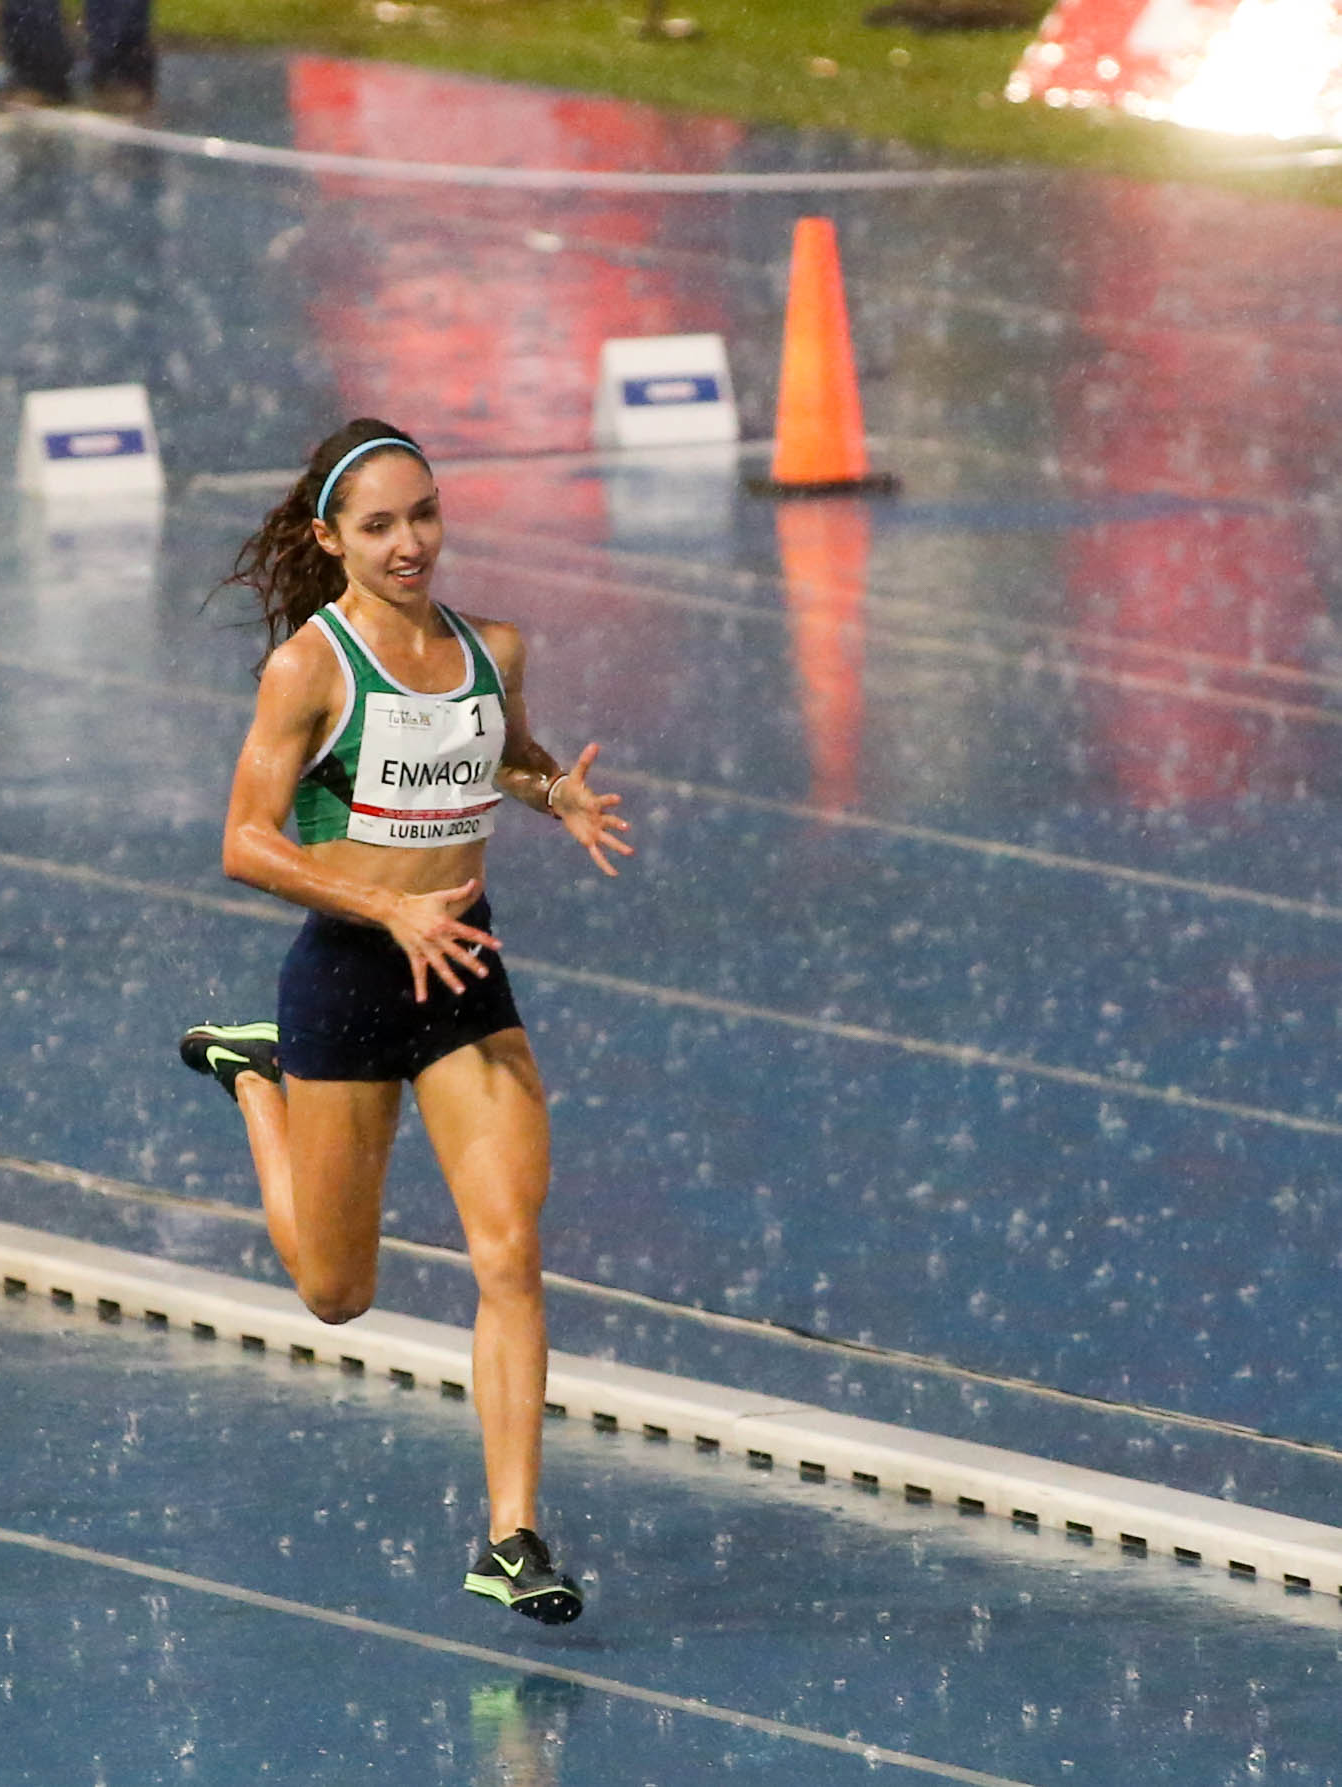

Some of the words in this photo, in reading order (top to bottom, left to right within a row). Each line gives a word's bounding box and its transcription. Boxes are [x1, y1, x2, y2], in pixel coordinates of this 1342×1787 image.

[470, 703, 486, 737] 1
[389, 823, 444, 839] LUBLIN
[447, 818, 481, 837] 2020
